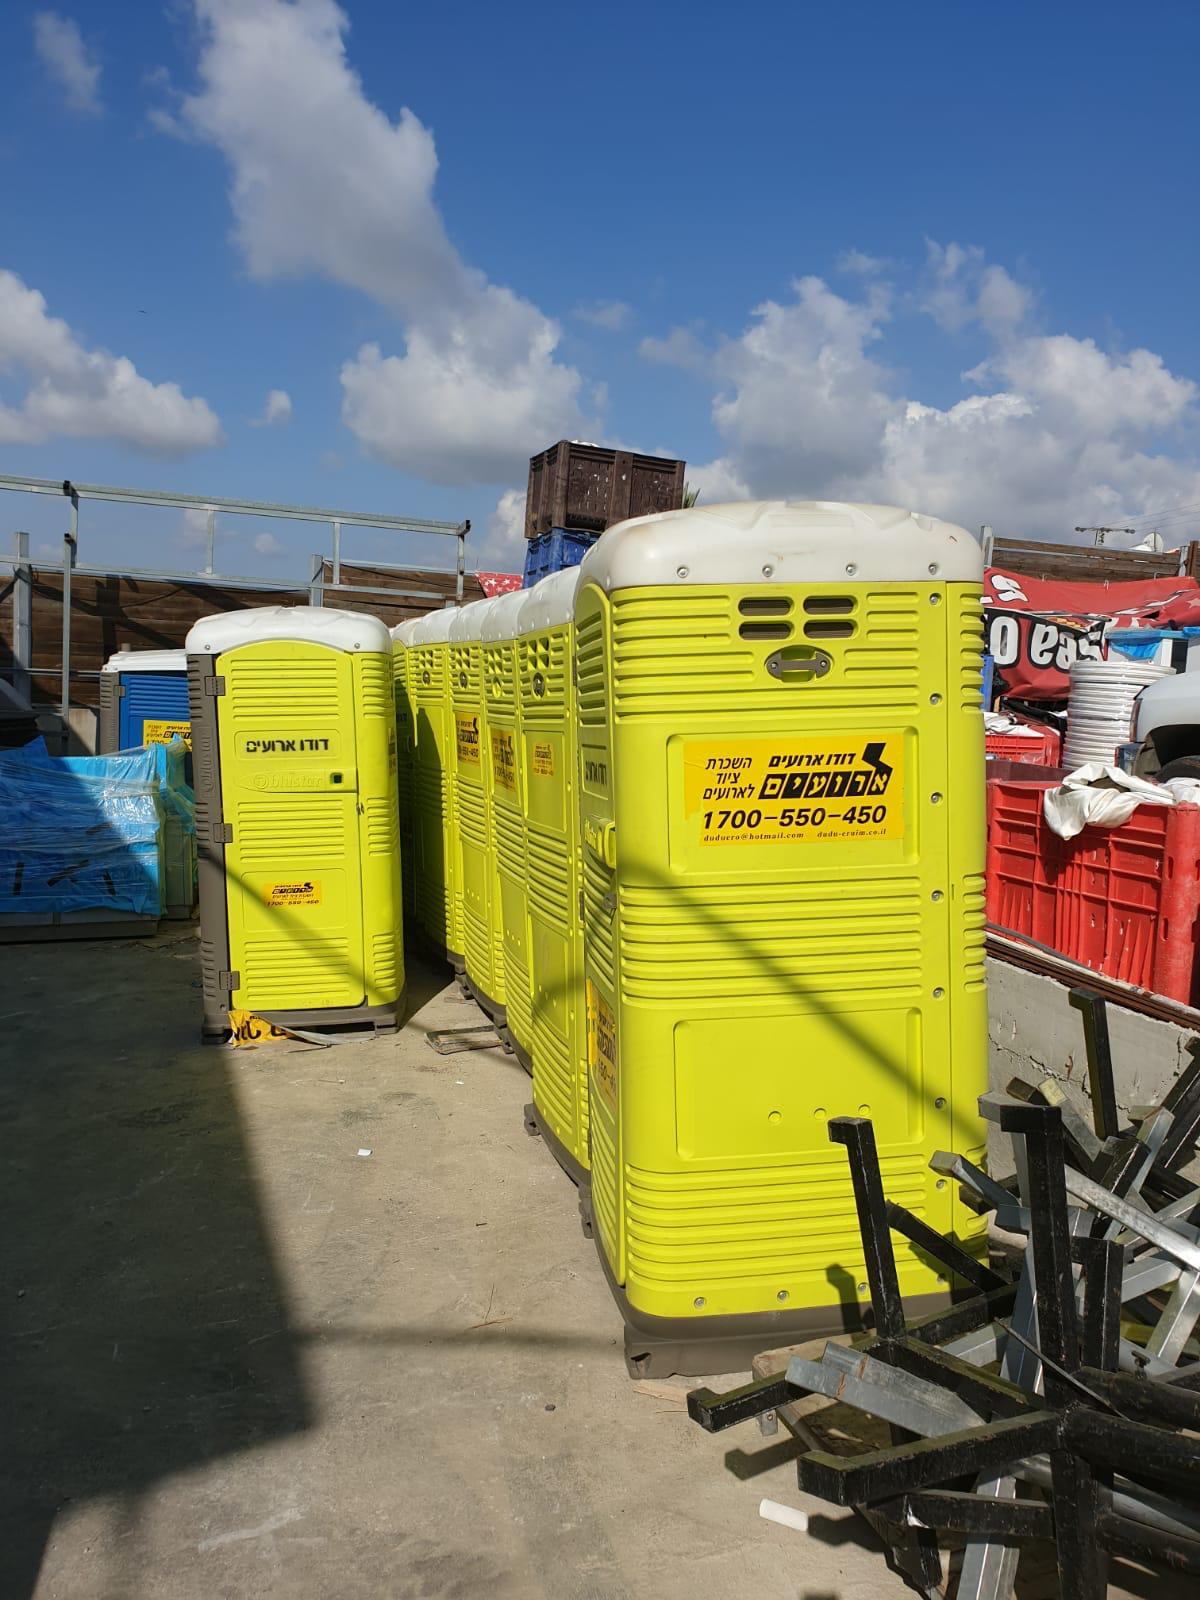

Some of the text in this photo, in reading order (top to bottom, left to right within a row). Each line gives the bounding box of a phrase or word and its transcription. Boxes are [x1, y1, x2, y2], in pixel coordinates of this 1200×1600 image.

[246, 738, 329, 753] דודו ארועים
[705, 757, 752, 770] השכרת
[768, 753, 856, 768] דודו ארועים
[716, 772, 740, 784] ציוד
[759, 771, 891, 800] ארועים
[703, 784, 755, 800] לארועים
[703, 805, 887, 830] 1700-550-450
